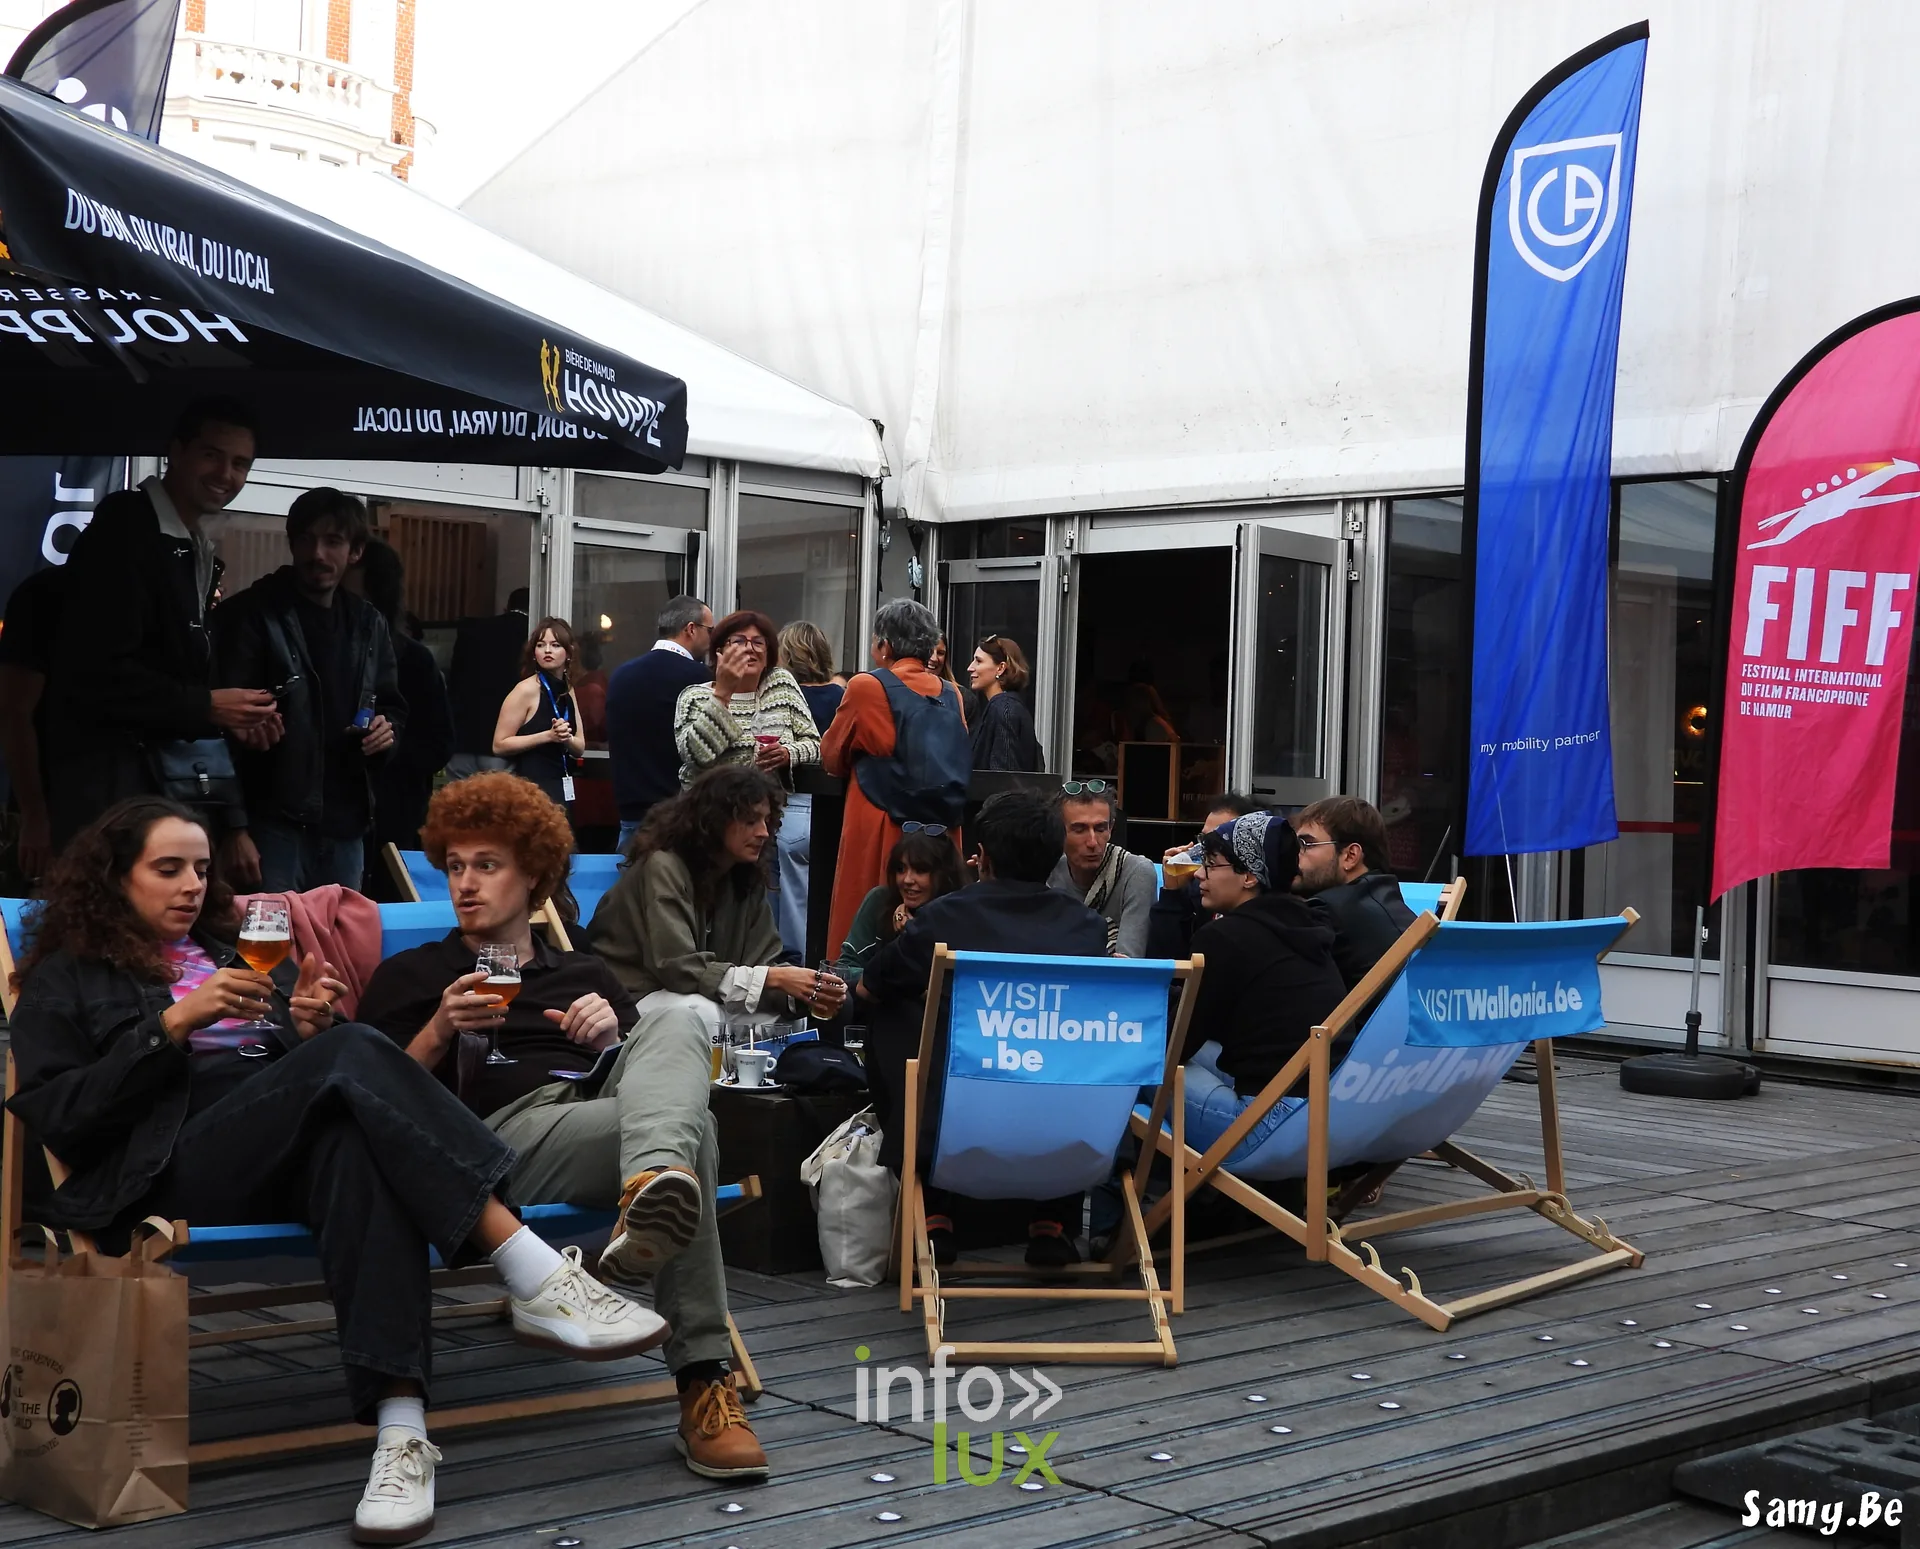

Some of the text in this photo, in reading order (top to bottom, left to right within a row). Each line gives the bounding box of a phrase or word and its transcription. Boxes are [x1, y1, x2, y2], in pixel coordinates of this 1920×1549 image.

[64, 188, 97, 234] DU
[129, 214, 160, 256] DU
[202, 238, 224, 279] DU
[226, 245, 275, 294] LOCAL
[565, 348, 616, 383] BIÈRE DE NAMUR
[564, 369, 667, 448] HOUPPE
[1743, 565, 1911, 666] FIFF
[1741, 663, 1883, 688] FESTIVAL INTERNATIONAL
[1740, 701, 1792, 719] DE NAMUR
[1741, 682, 1870, 707] DU FILM FRANCOPHONE
[1480, 730, 1601, 756] my mobility partner
[978, 980, 1070, 1011] VISIT
[976, 1009, 1143, 1043] Wallonia
[982, 1040, 1044, 1072] .be
[21, 1402, 42, 1415] THE
